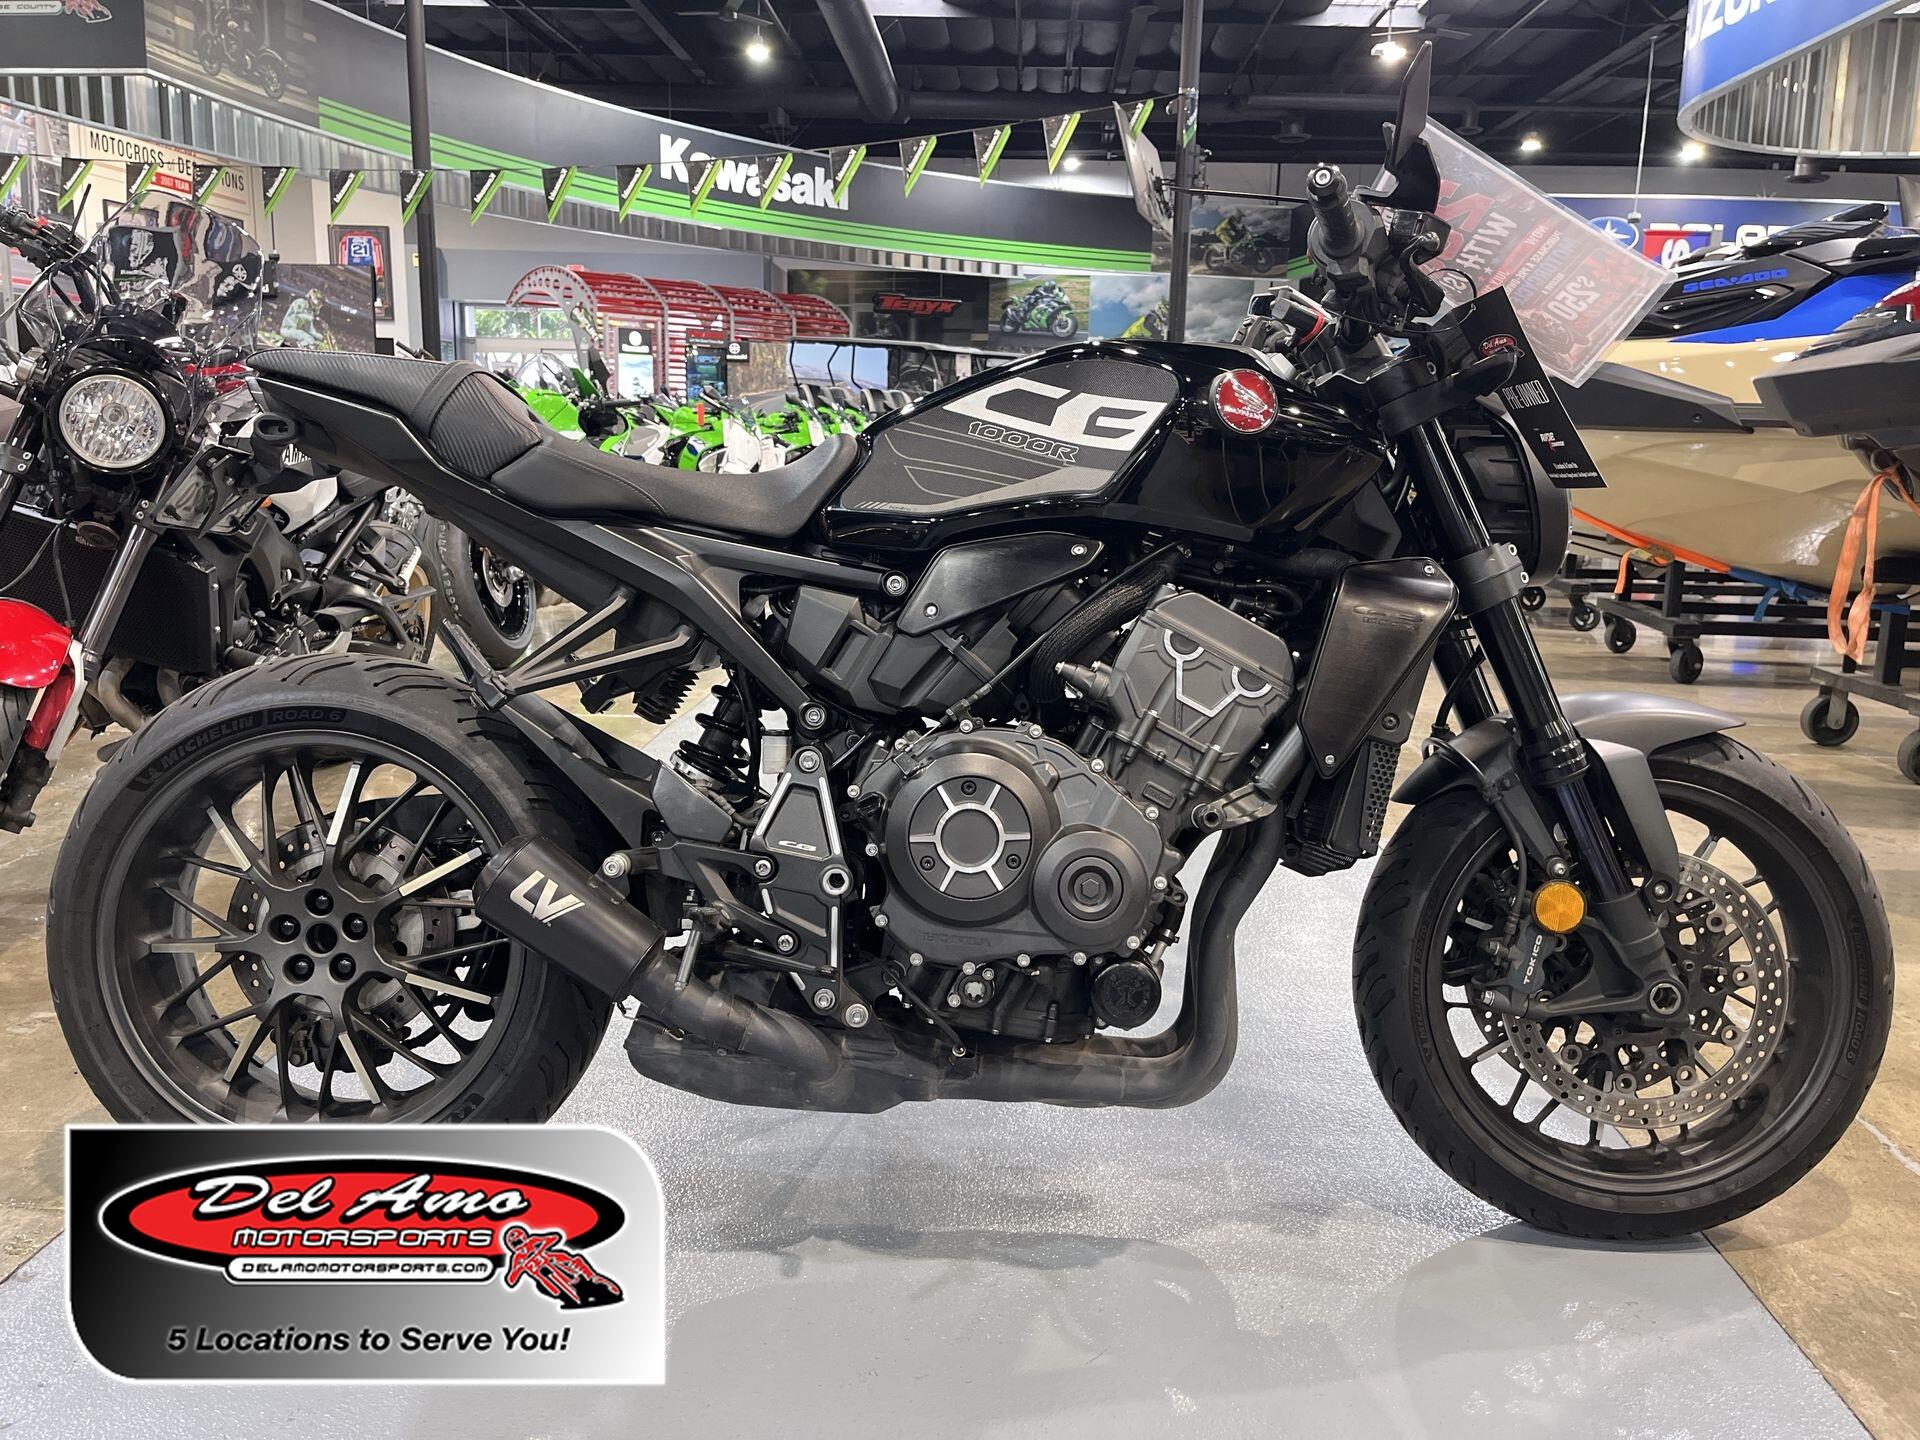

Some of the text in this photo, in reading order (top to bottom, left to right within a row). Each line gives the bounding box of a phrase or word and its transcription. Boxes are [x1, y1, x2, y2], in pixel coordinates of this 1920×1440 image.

[90, 131, 165, 168] MOTOCROSS
[352, 243, 369, 256] 21
[1502, 379, 1550, 410] PRE-OWNED
[968, 421, 1079, 463] 1000R
[160, 709, 342, 770] MICHELIN ROAD 6
[1523, 934, 1543, 985] TOKICO
